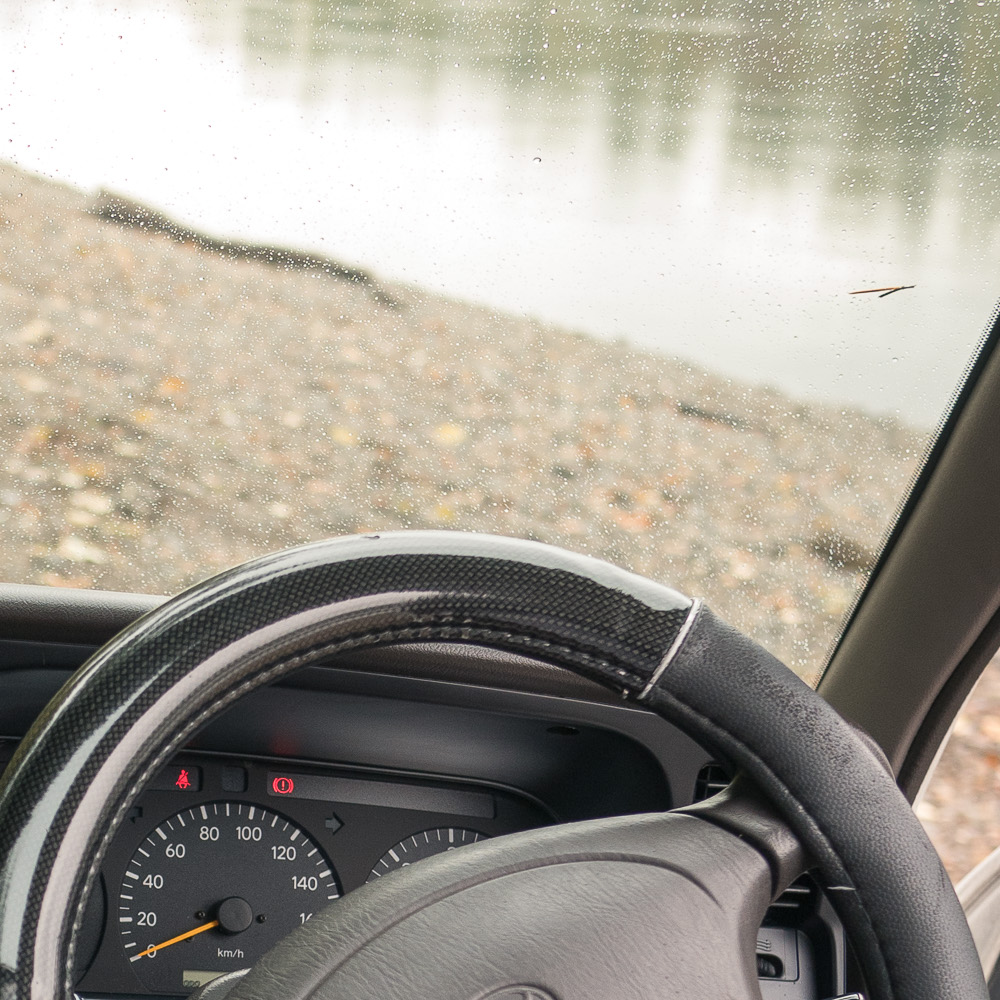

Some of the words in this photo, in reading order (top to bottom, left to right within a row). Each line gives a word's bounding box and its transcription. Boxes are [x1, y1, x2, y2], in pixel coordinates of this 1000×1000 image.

[199, 826, 220, 841] 80
[236, 826, 262, 841] 100
[165, 843, 186, 858] 60
[271, 845, 297, 861] 120
[142, 874, 164, 889] 40
[291, 876, 318, 891] 140
[137, 911, 157, 927] 20
[146, 943, 157, 959] 0
[217, 948, 244, 958] km/h
